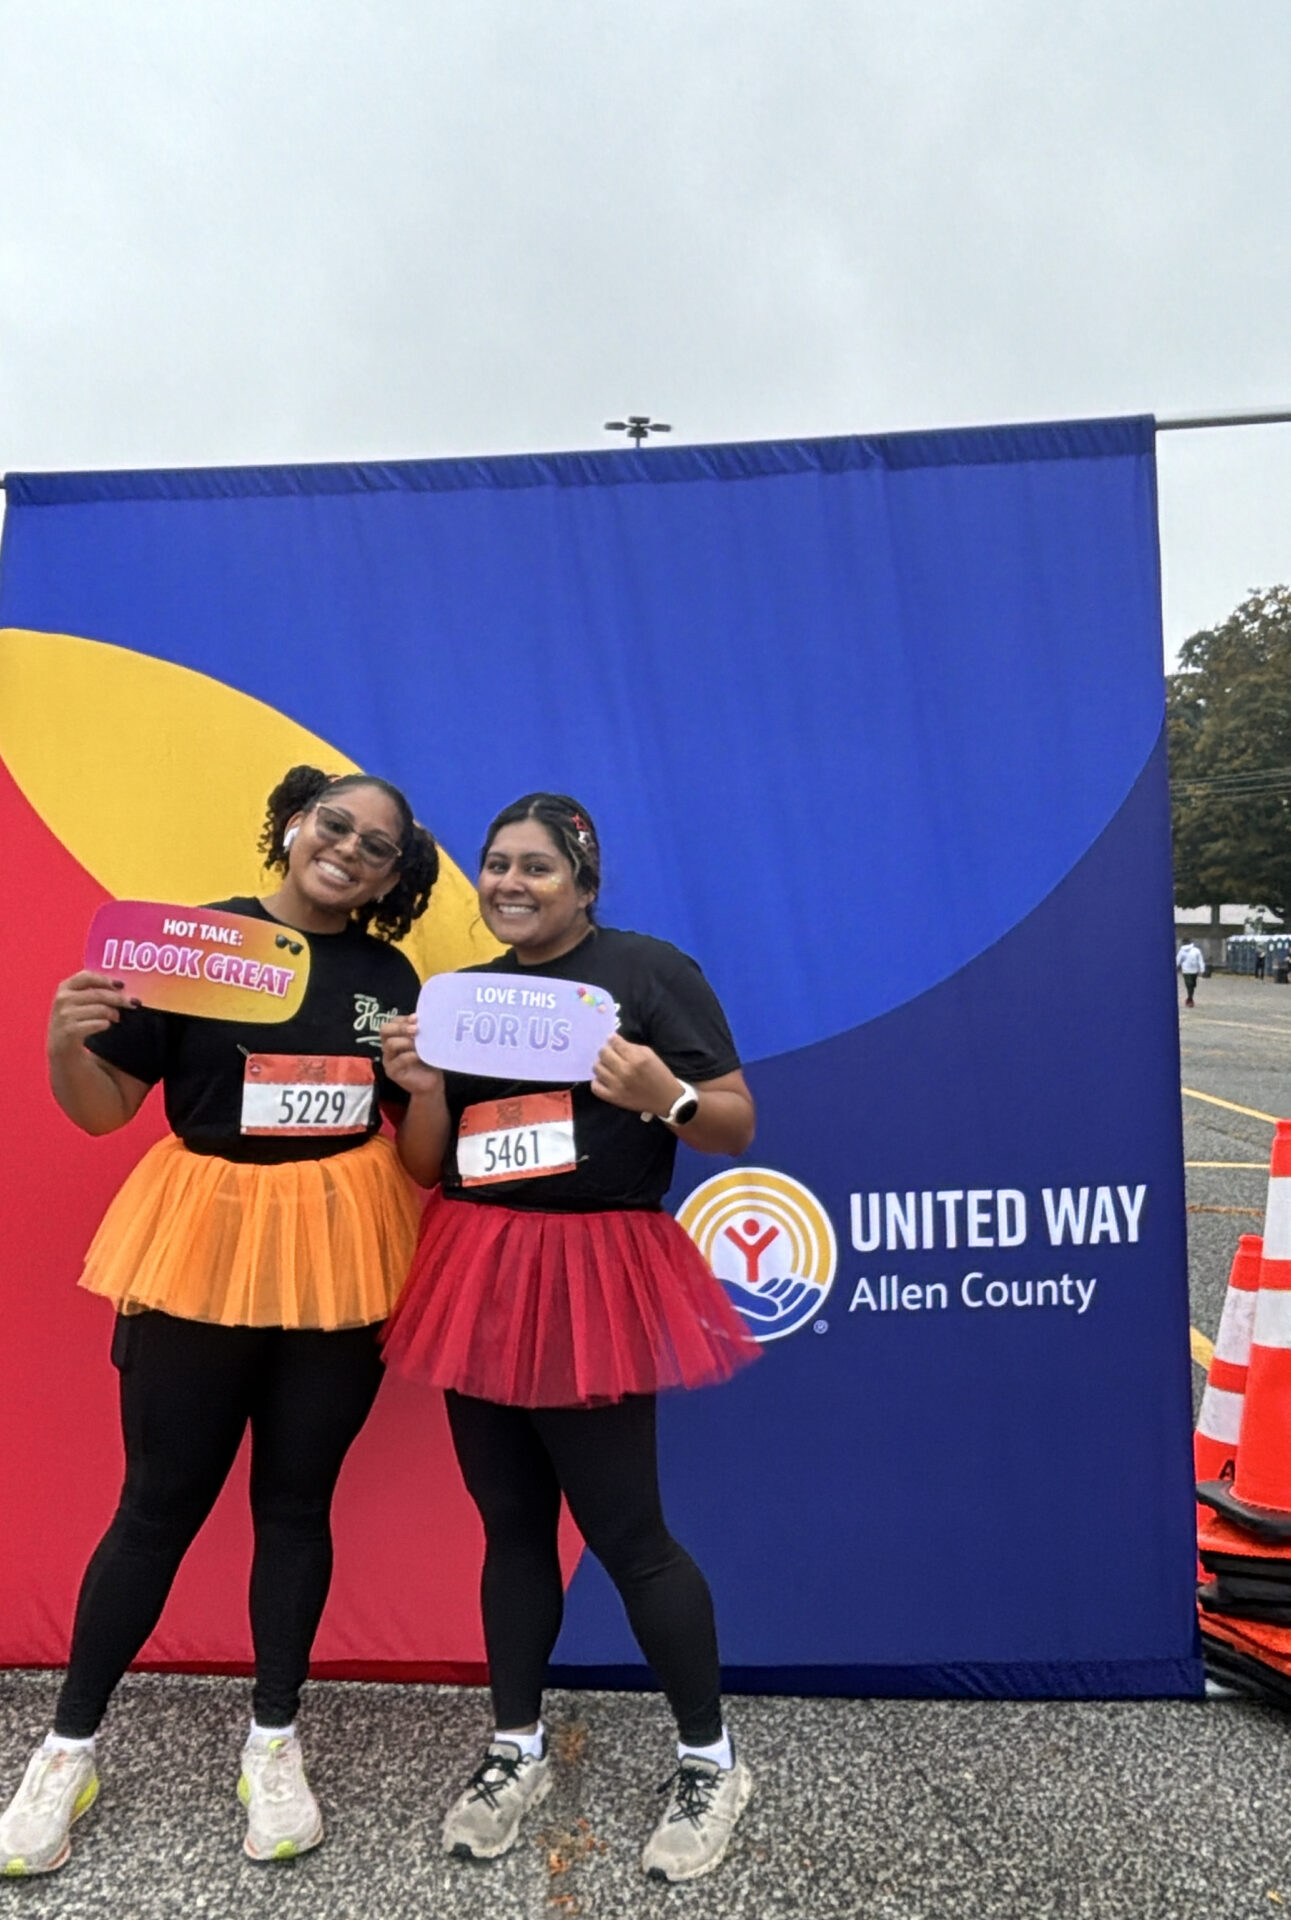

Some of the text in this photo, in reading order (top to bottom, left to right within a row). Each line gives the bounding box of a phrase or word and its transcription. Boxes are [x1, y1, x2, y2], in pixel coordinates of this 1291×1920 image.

[163, 918, 244, 947] HOT TAKE:
[102, 938, 295, 998] I LOOK GREAT
[476, 987, 556, 1009] LOVE THIS
[454, 1010, 572, 1052] FOR US
[278, 1090, 346, 1124] 5229
[484, 1130, 540, 1172] 5461
[849, 1184, 1147, 1252] UNITED WAY
[849, 1272, 1097, 1314] Allen County
